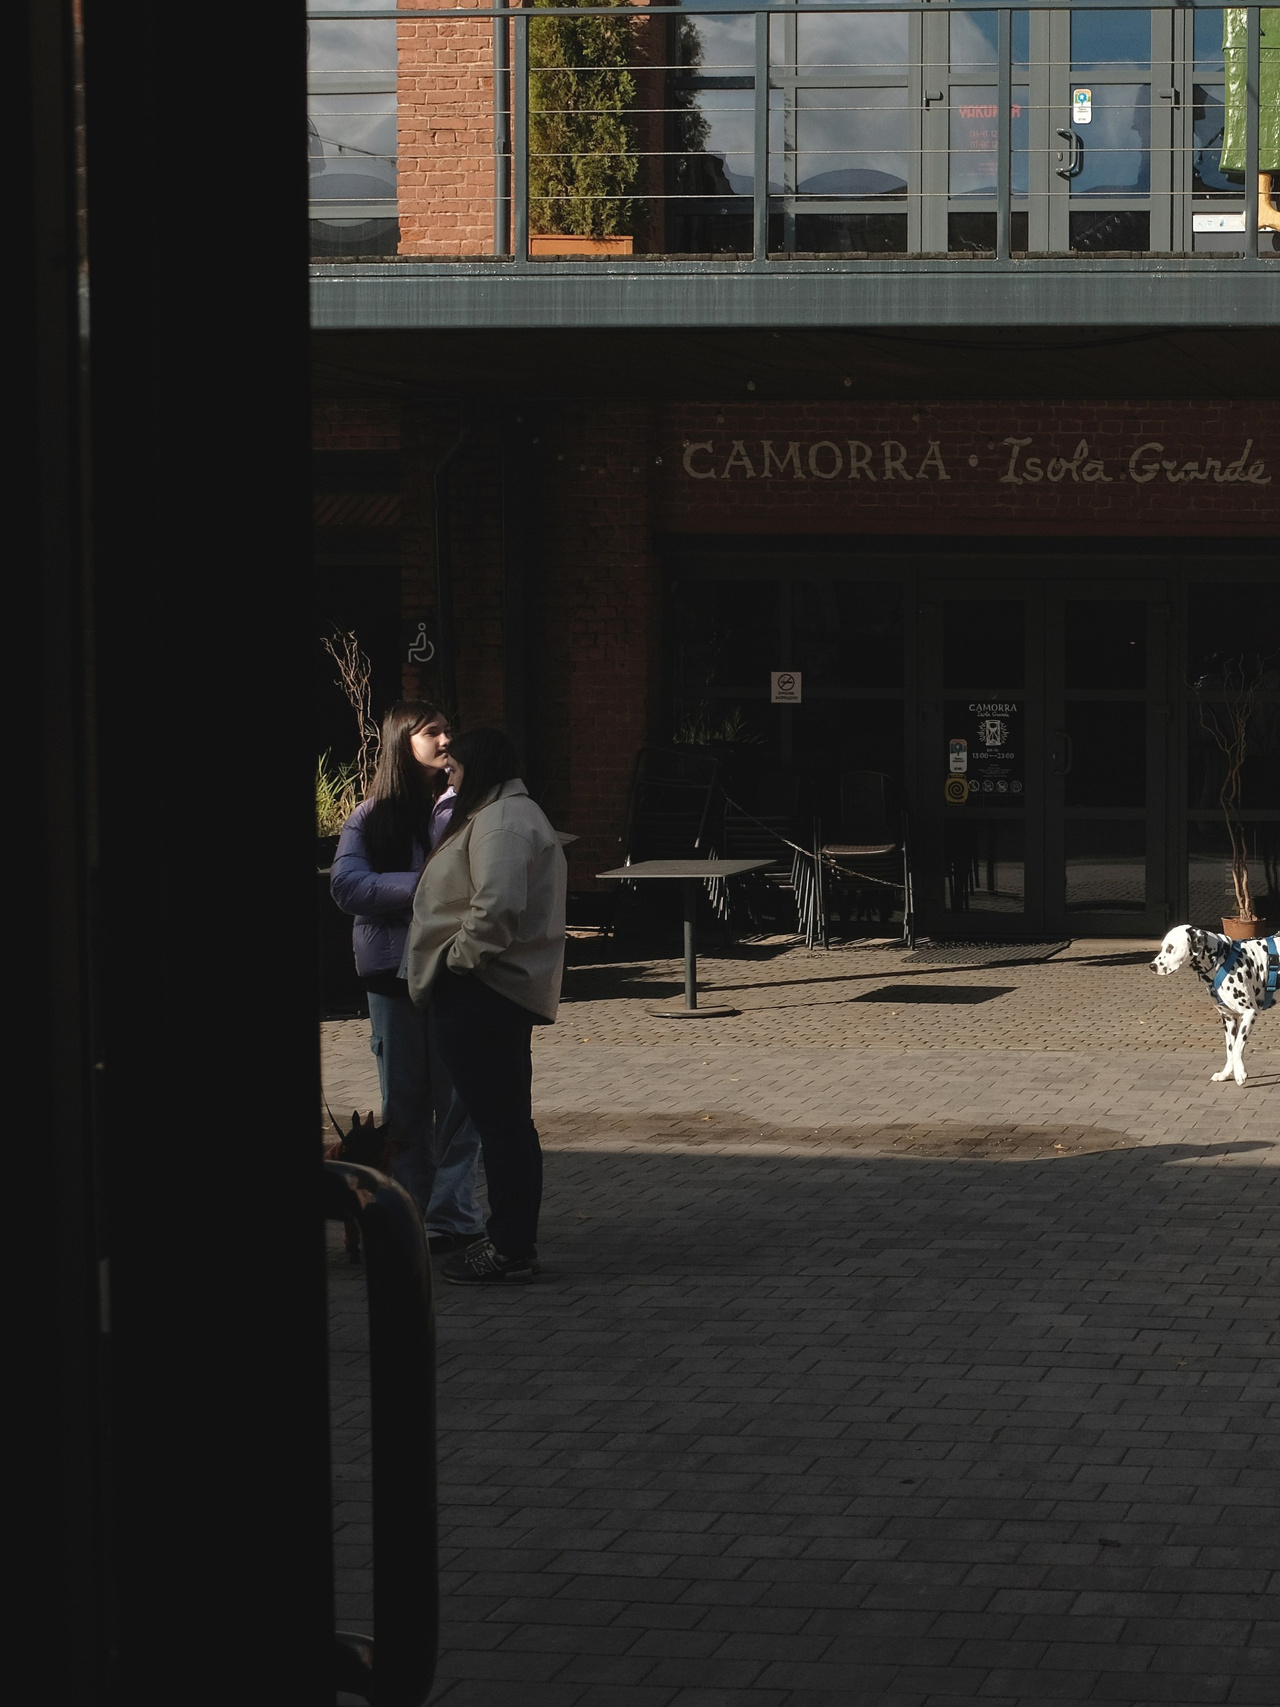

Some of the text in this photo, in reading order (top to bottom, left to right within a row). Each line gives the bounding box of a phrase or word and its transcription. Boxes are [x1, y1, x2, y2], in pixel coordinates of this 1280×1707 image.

[682, 437, 1272, 485] CAMORRA Isola Grande
[968, 703, 1018, 712] CAMORRA
